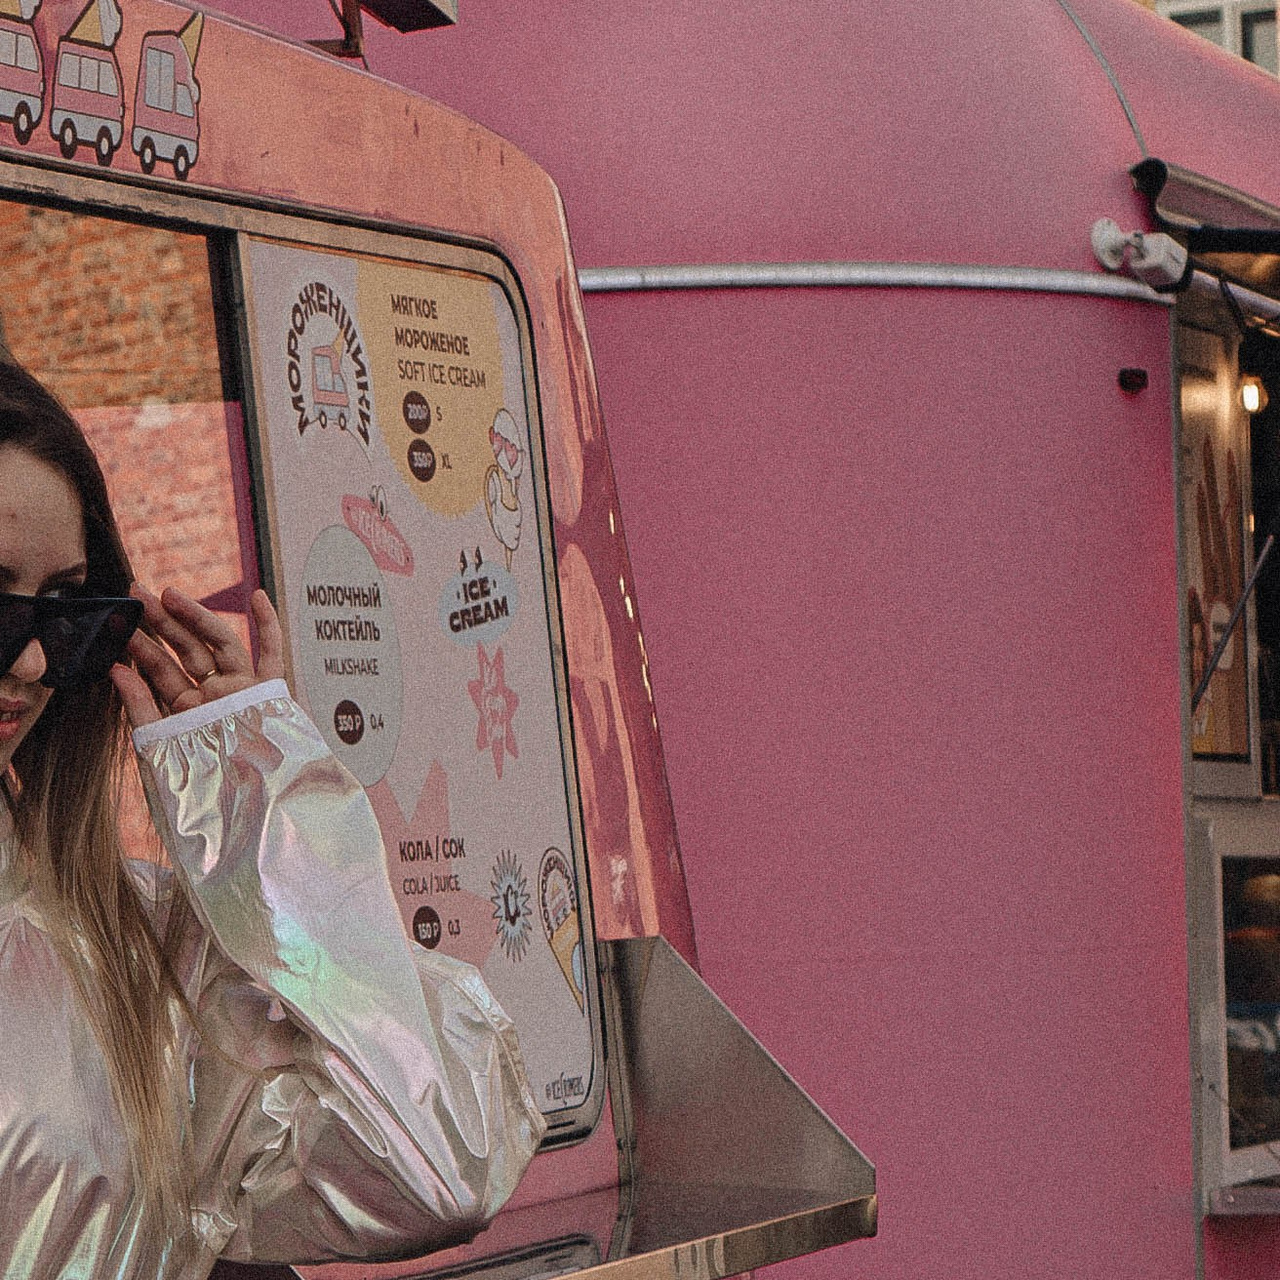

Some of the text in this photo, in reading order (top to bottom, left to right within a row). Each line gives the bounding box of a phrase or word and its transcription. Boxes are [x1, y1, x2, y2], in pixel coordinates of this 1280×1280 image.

[390, 293, 439, 320] МЯГКОЕ
[394, 326, 470, 357] МОРОЖЕНОЕ
[287, 282, 371, 447] МОРОЖЕНЩИКИ
[397, 359, 487, 389] SOFT ICE CREAM
[435, 406, 443, 421] S
[306, 582, 382, 609] МОЛОЧНЫЙ
[461, 576, 491, 604] ICE
[314, 614, 381, 642] КОКТЕЙЛЬ
[448, 595, 510, 633] CREAM
[324, 658, 380, 676] MILKSHAKE
